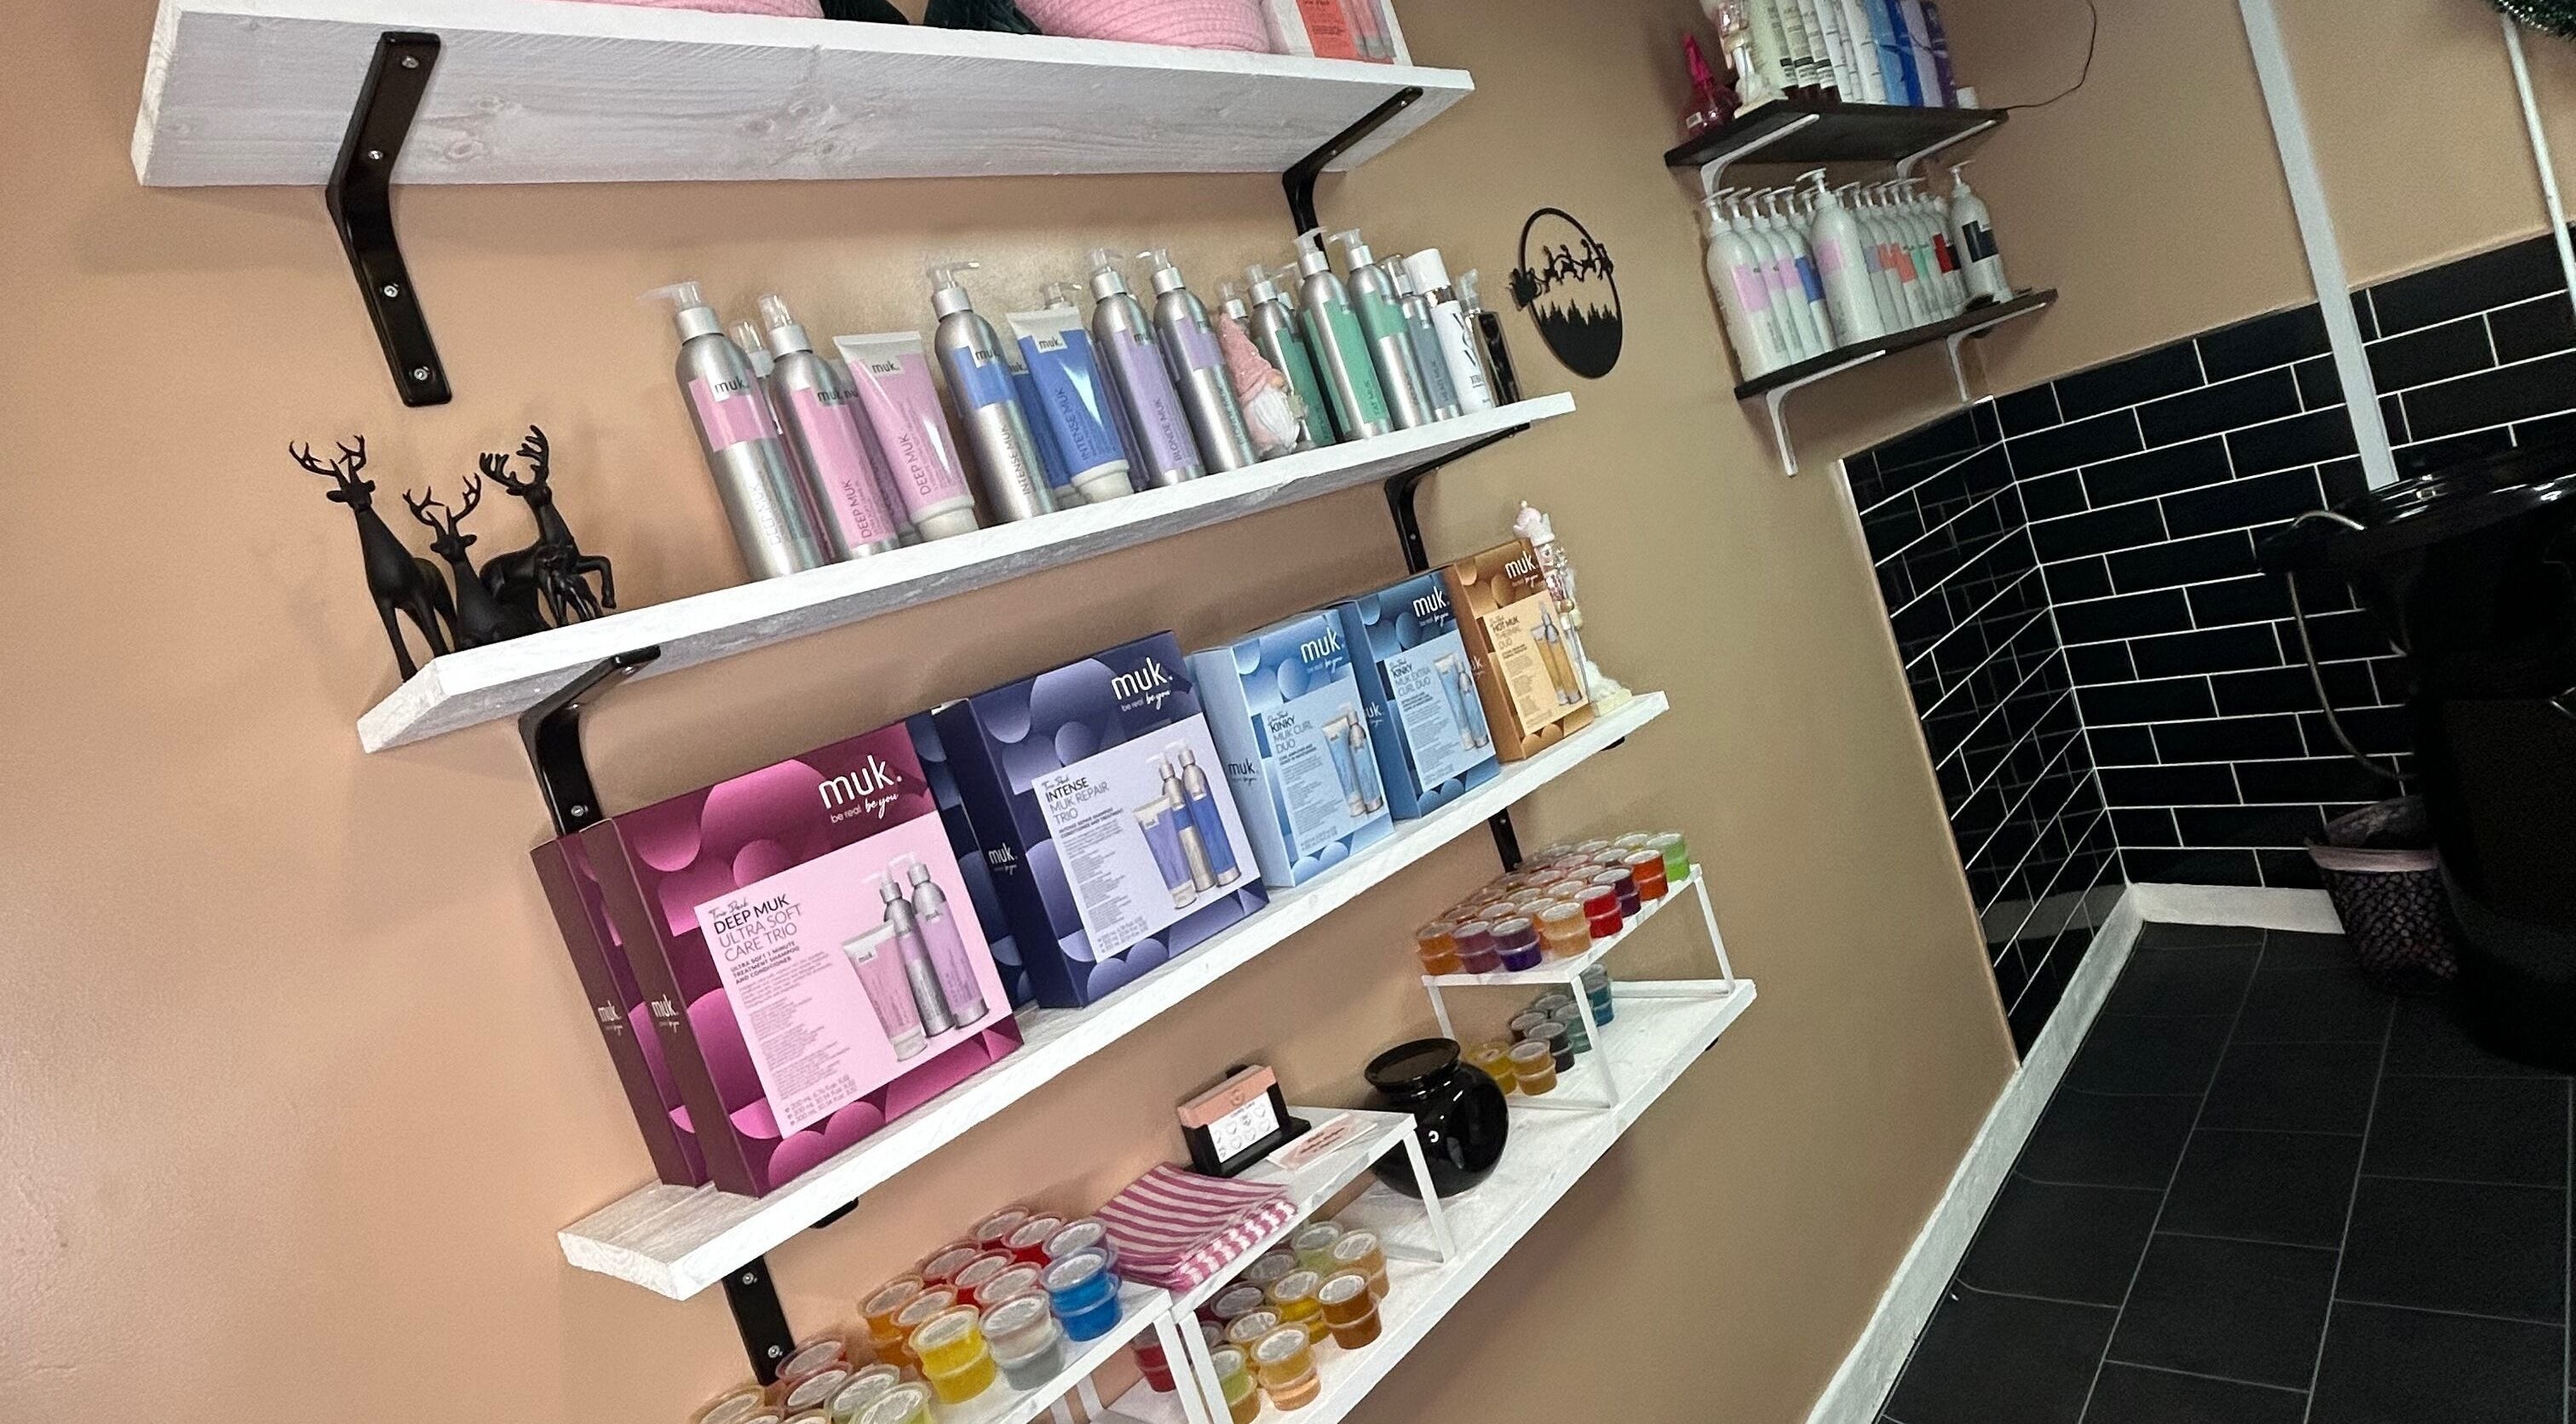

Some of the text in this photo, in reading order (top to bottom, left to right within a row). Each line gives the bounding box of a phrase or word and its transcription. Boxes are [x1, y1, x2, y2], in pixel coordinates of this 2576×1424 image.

[1055, 387, 1090, 461] INTENSE MUK
[1153, 397, 1183, 462] BLONDE MUK
[897, 433, 931, 497] DEEP MUK
[1000, 423, 1031, 495] INTENSE MUK
[842, 479, 872, 539] DEEP MUK
[1111, 657, 1173, 700] muk.
[1270, 715, 1297, 733] KINKY
[1275, 738, 1296, 755] DUO
[819, 755, 902, 809] muk.
[1045, 777, 1090, 803] INTENSE
[1049, 781, 1109, 814] MUK REPAIR
[831, 794, 899, 824] be real be you
[1053, 807, 1078, 824] TRIO
[714, 894, 789, 934] DEEP MUK
[719, 903, 802, 948] ULTRA SOFT
[724, 922, 797, 962] CARE TRIO
